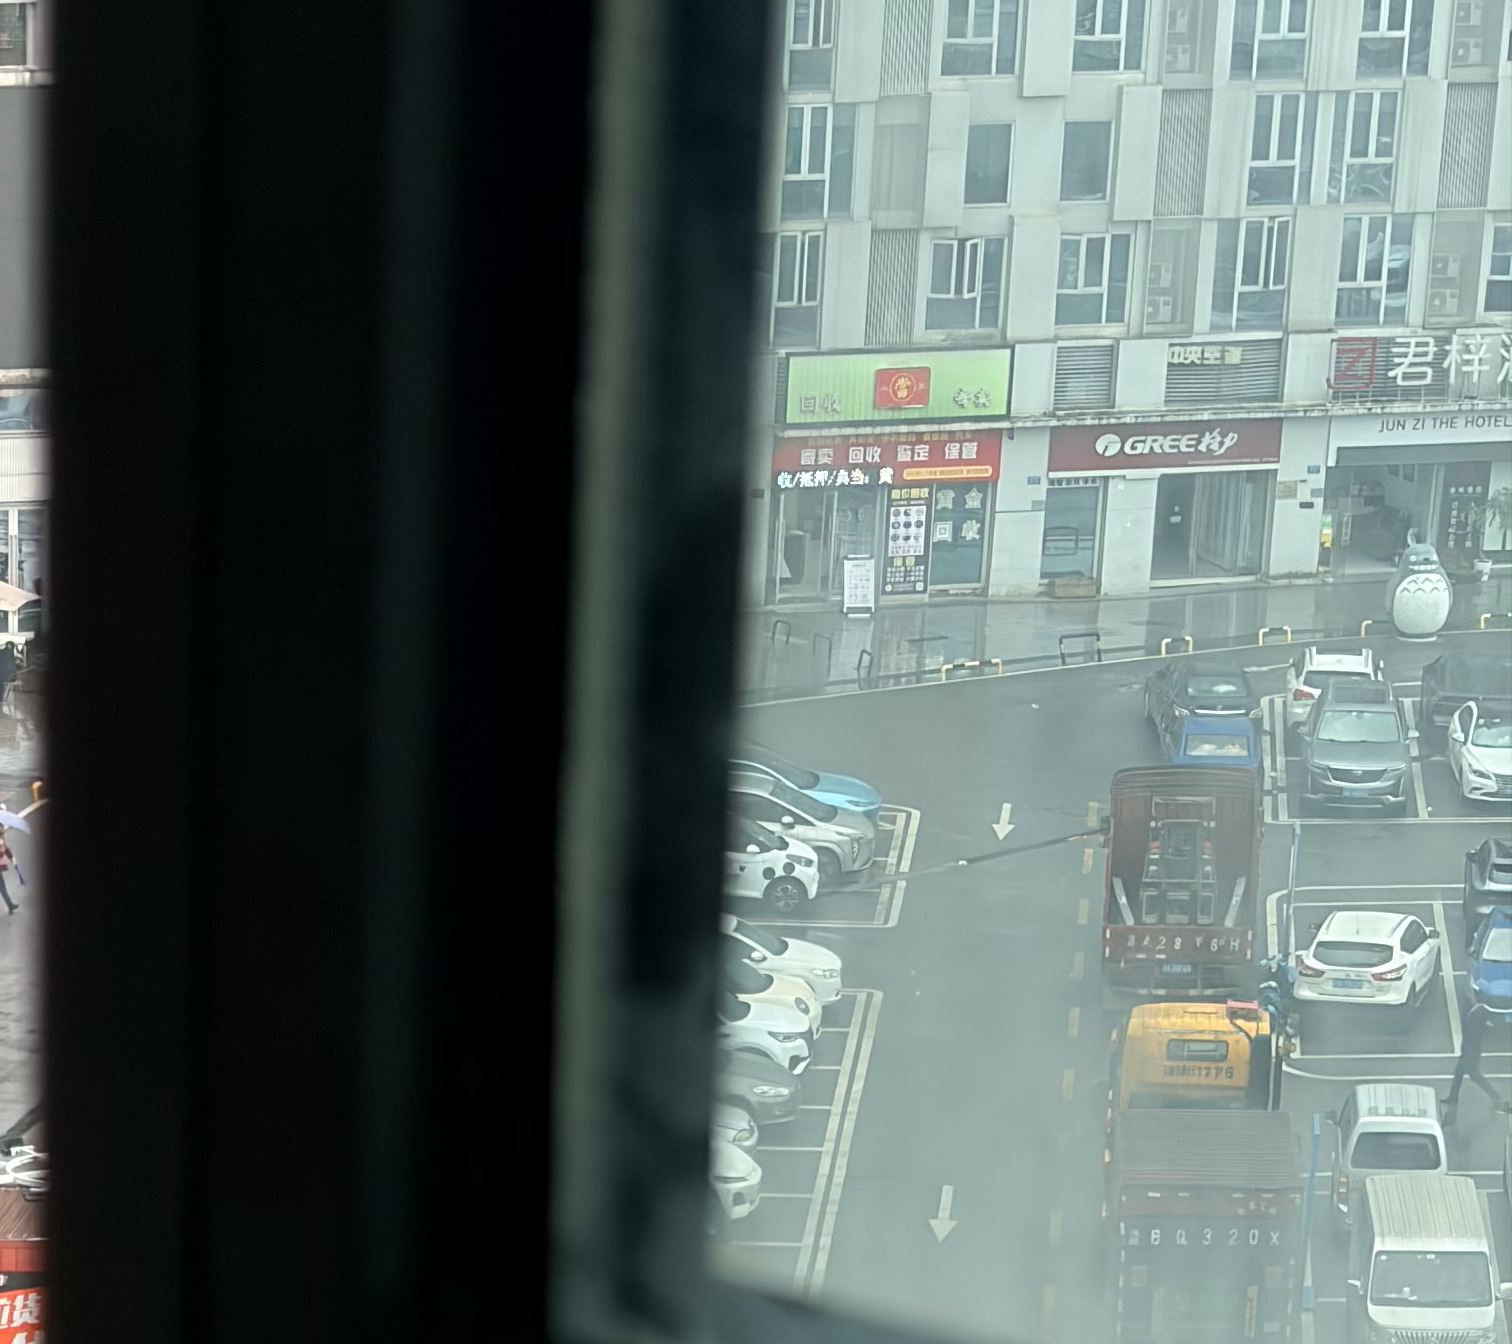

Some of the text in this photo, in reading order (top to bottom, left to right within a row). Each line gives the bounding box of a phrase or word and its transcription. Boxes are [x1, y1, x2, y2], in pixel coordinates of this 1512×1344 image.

[1378, 415, 1512, 433] JUN ZI THE HOTEL
[1123, 433, 1199, 455] GREE
[848, 446, 881, 464] 回收
